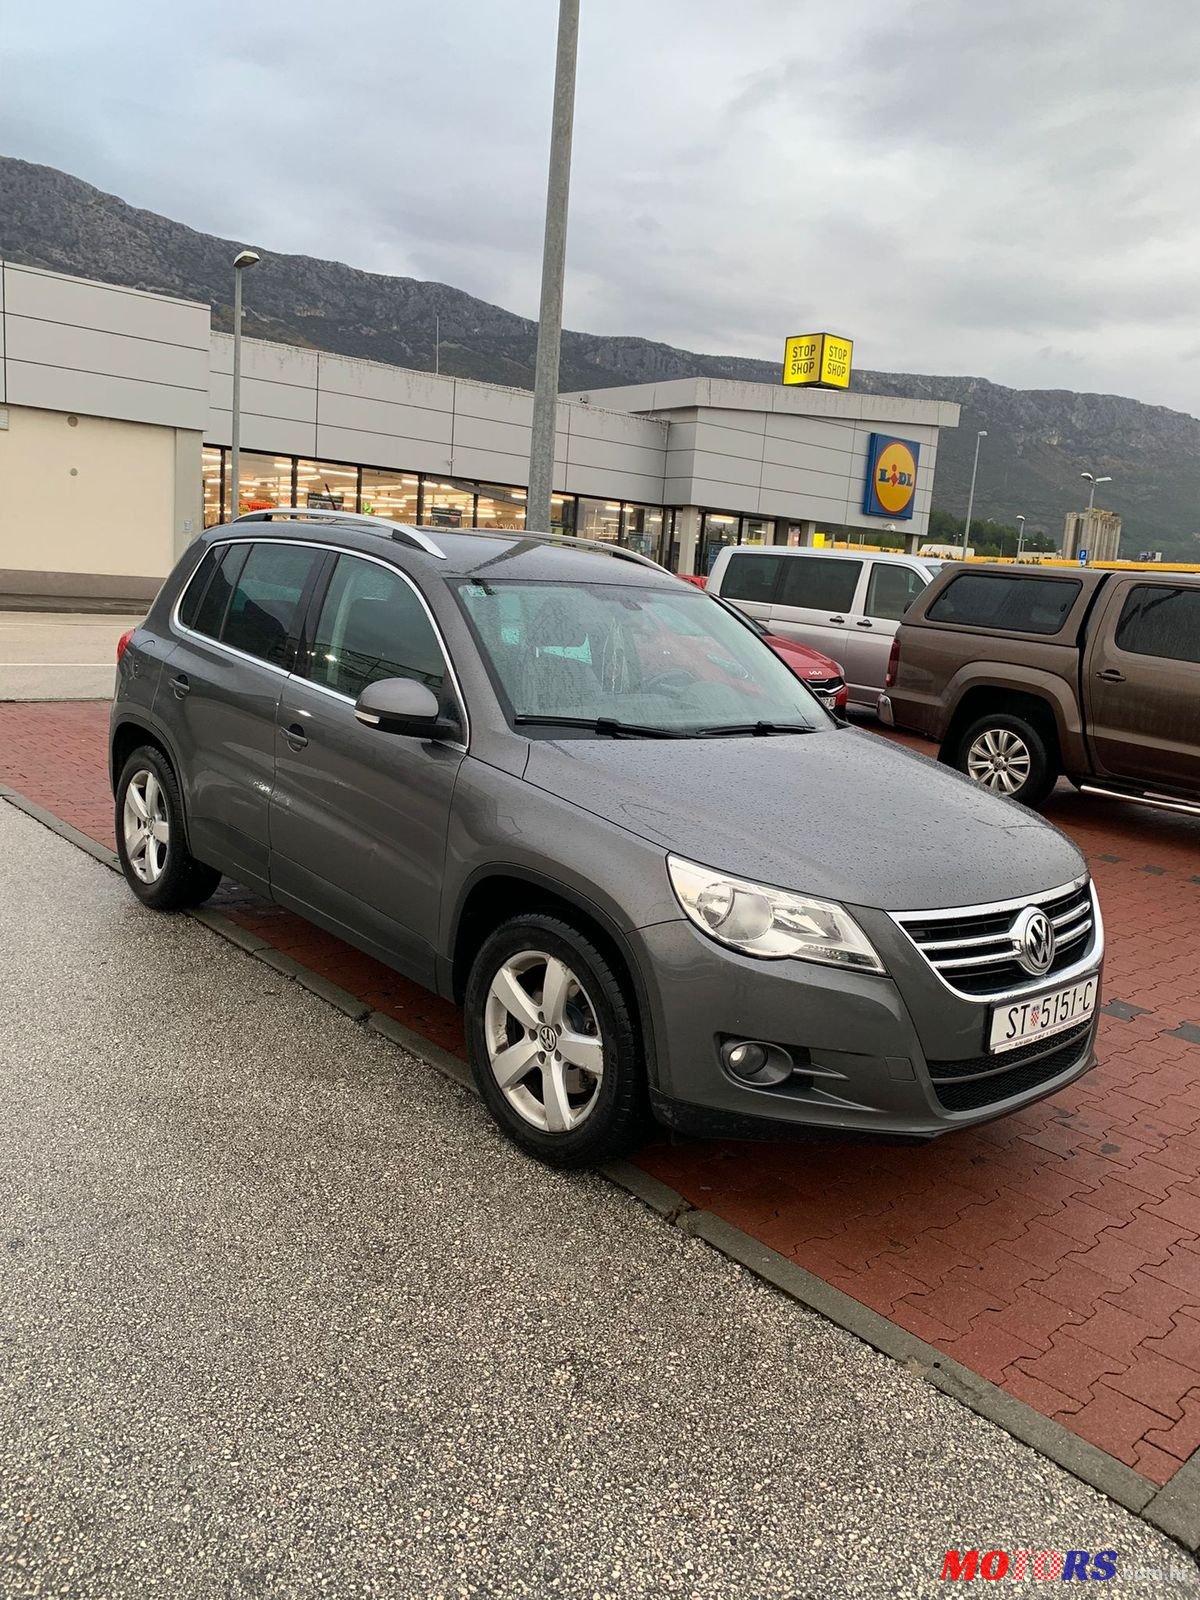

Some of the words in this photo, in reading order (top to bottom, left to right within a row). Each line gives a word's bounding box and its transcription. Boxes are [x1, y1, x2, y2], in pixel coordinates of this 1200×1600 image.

[792, 344, 816, 359] STOP
[828, 345, 848, 361] STOP
[791, 361, 815, 375] SHOP
[827, 362, 847, 377] SHOP
[1006, 1004, 1031, 1039] ST
